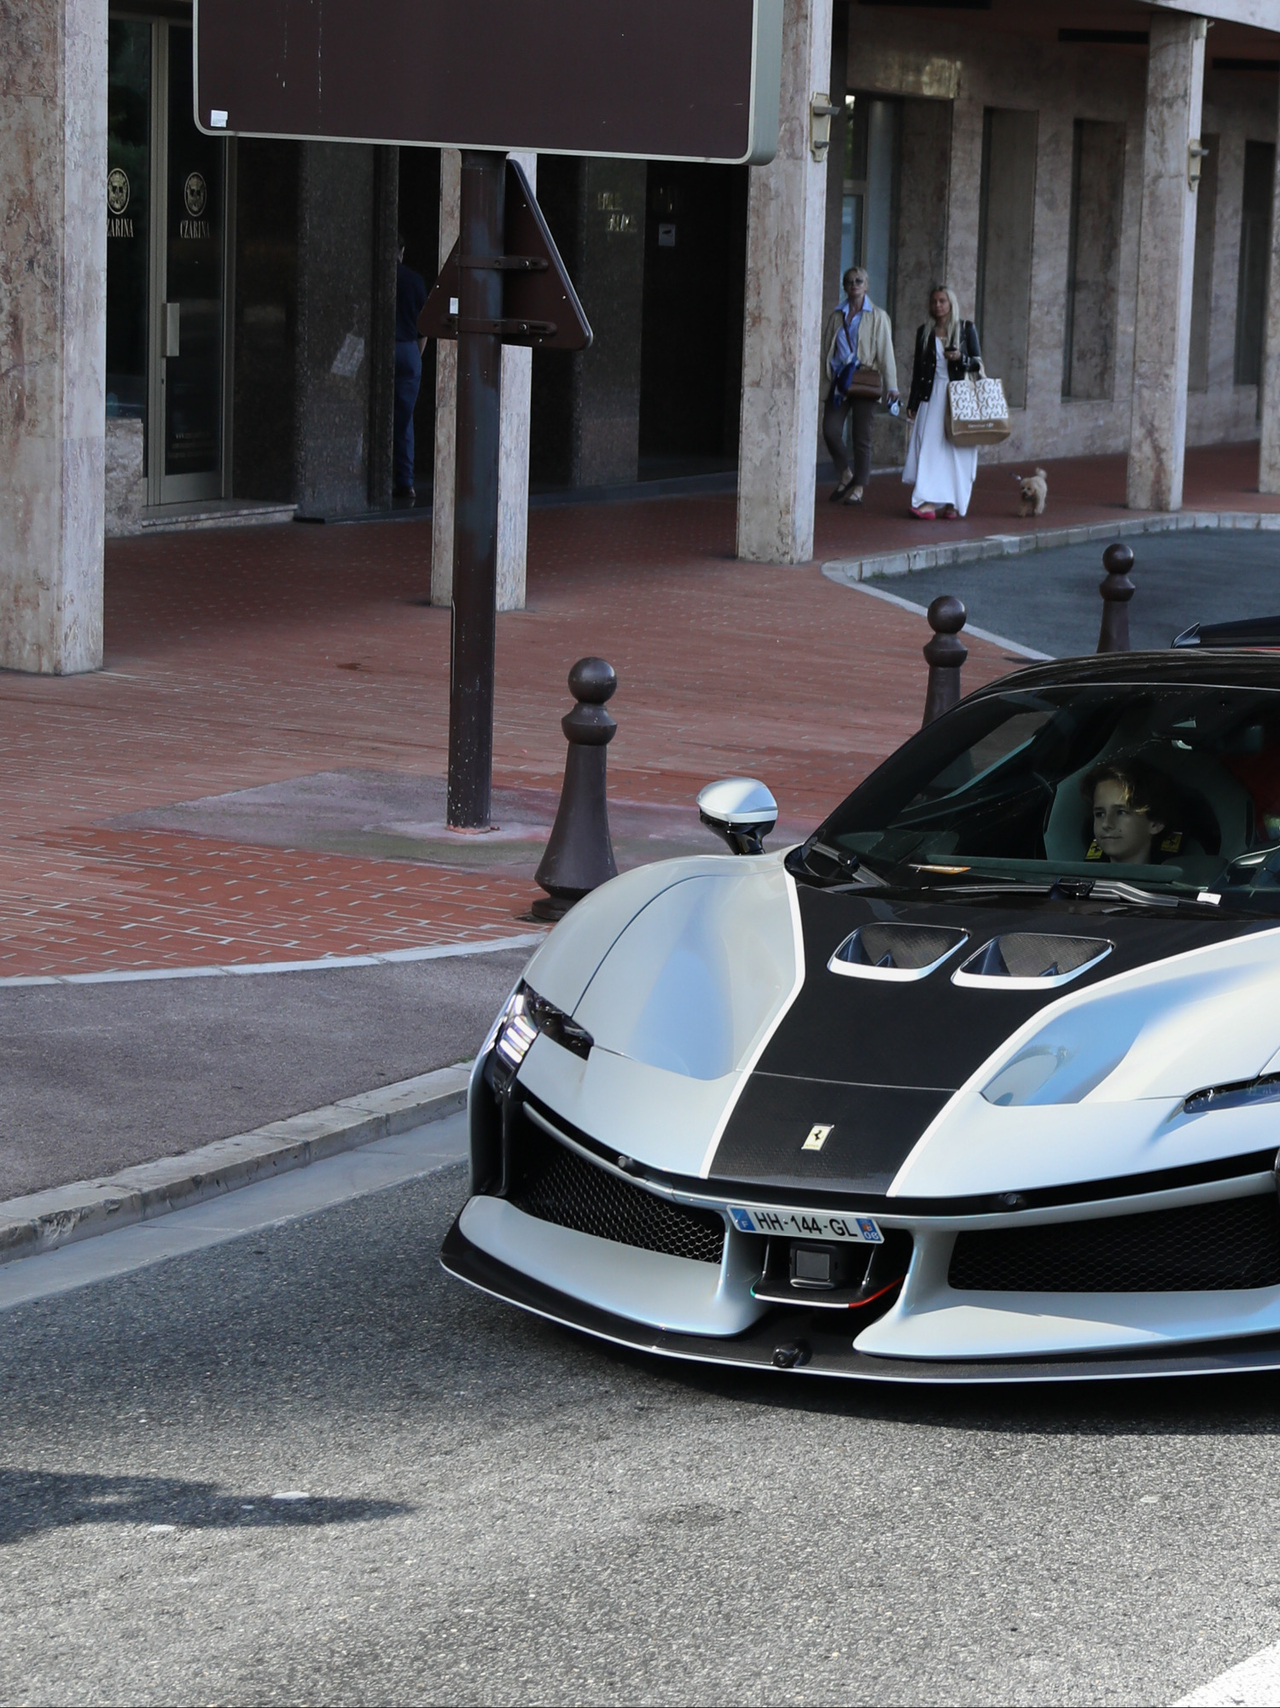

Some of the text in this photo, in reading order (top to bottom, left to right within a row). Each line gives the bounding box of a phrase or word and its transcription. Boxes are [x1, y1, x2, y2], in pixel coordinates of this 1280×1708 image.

[107, 218, 134, 238] ZARINA
[180, 220, 210, 239] CZARINA
[753, 1211, 858, 1238] HH-144-GL
